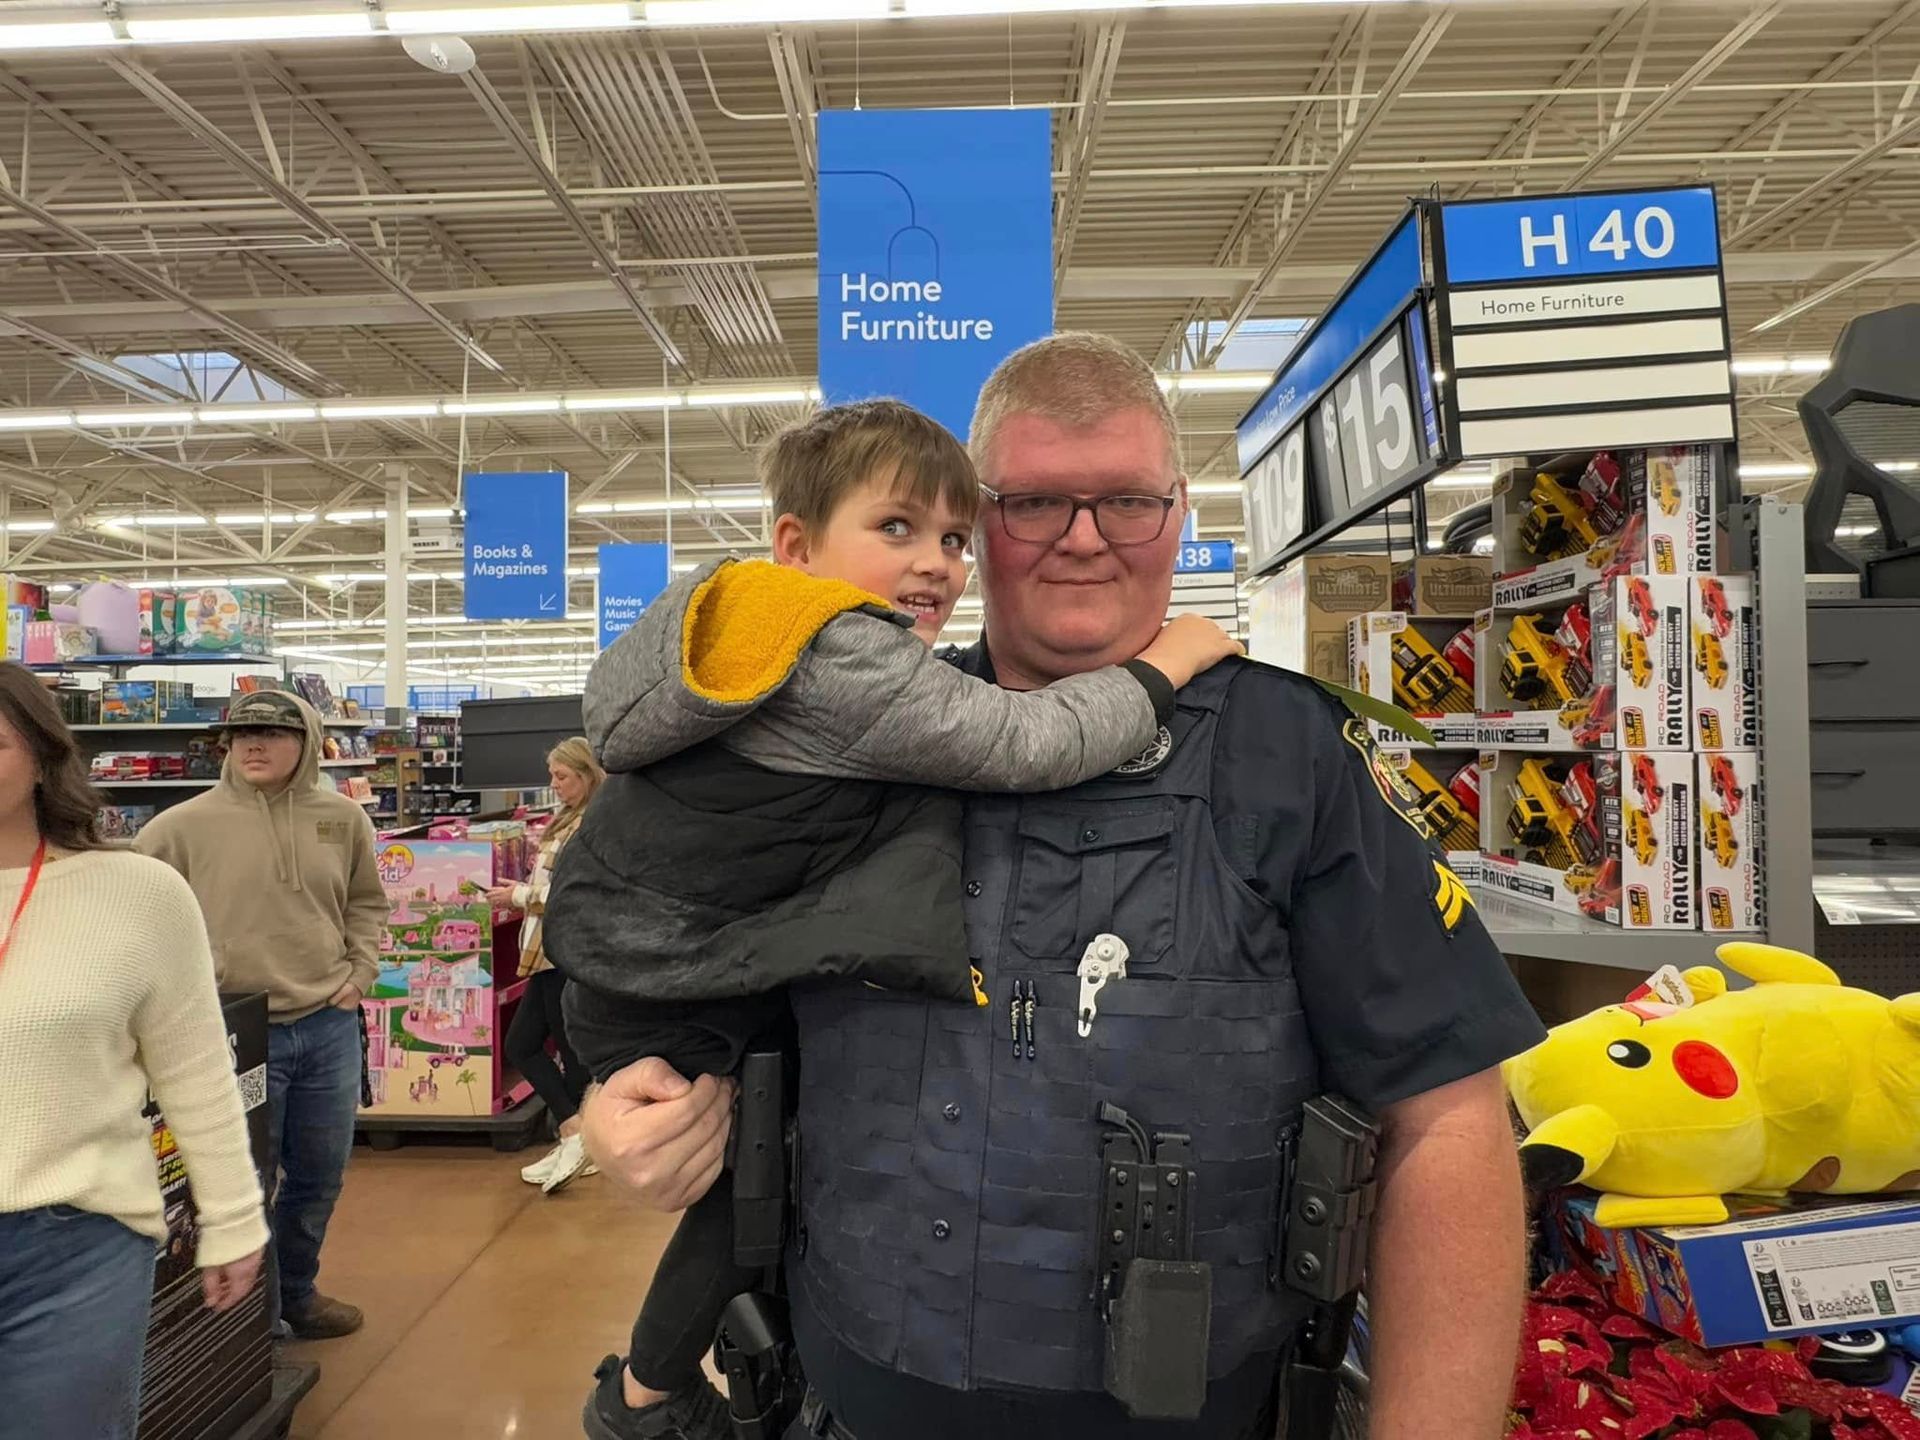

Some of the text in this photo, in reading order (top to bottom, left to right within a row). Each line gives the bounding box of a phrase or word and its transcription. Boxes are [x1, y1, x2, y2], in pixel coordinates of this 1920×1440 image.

[1520, 206, 1675, 267] H 40
[841, 273, 942, 302] Home
[1482, 292, 1625, 315] Home Furniture
[841, 311, 994, 341] Furniture
[1279, 386, 1296, 413] Price
[1695, 511, 1711, 572] RALLY
[474, 544, 517, 559] Books
[521, 544, 533, 559] &
[1185, 547, 1212, 567] 38
[473, 561, 548, 579] Magazines
[1687, 553, 1694, 572] RC
[1317, 582, 1380, 595] ULTIMATE
[1430, 582, 1489, 596] ULTIMATE
[1496, 585, 1529, 606] RALLY
[605, 595, 642, 607] Movies
[605, 608, 636, 619] Music
[605, 621, 631, 631] Gam
[1667, 683, 1682, 745] RALLY
[1742, 683, 1756, 746] RALLY
[1477, 729, 1506, 743] RALLY
[1658, 726, 1665, 745] RC
[1734, 727, 1741, 746] RC
[1120, 756, 1160, 773] OFFICE
[1482, 868, 1511, 889] RALLY
[1672, 860, 1688, 924] RALLY
[1664, 905, 1670, 923] RC
[1744, 907, 1751, 926] RC
